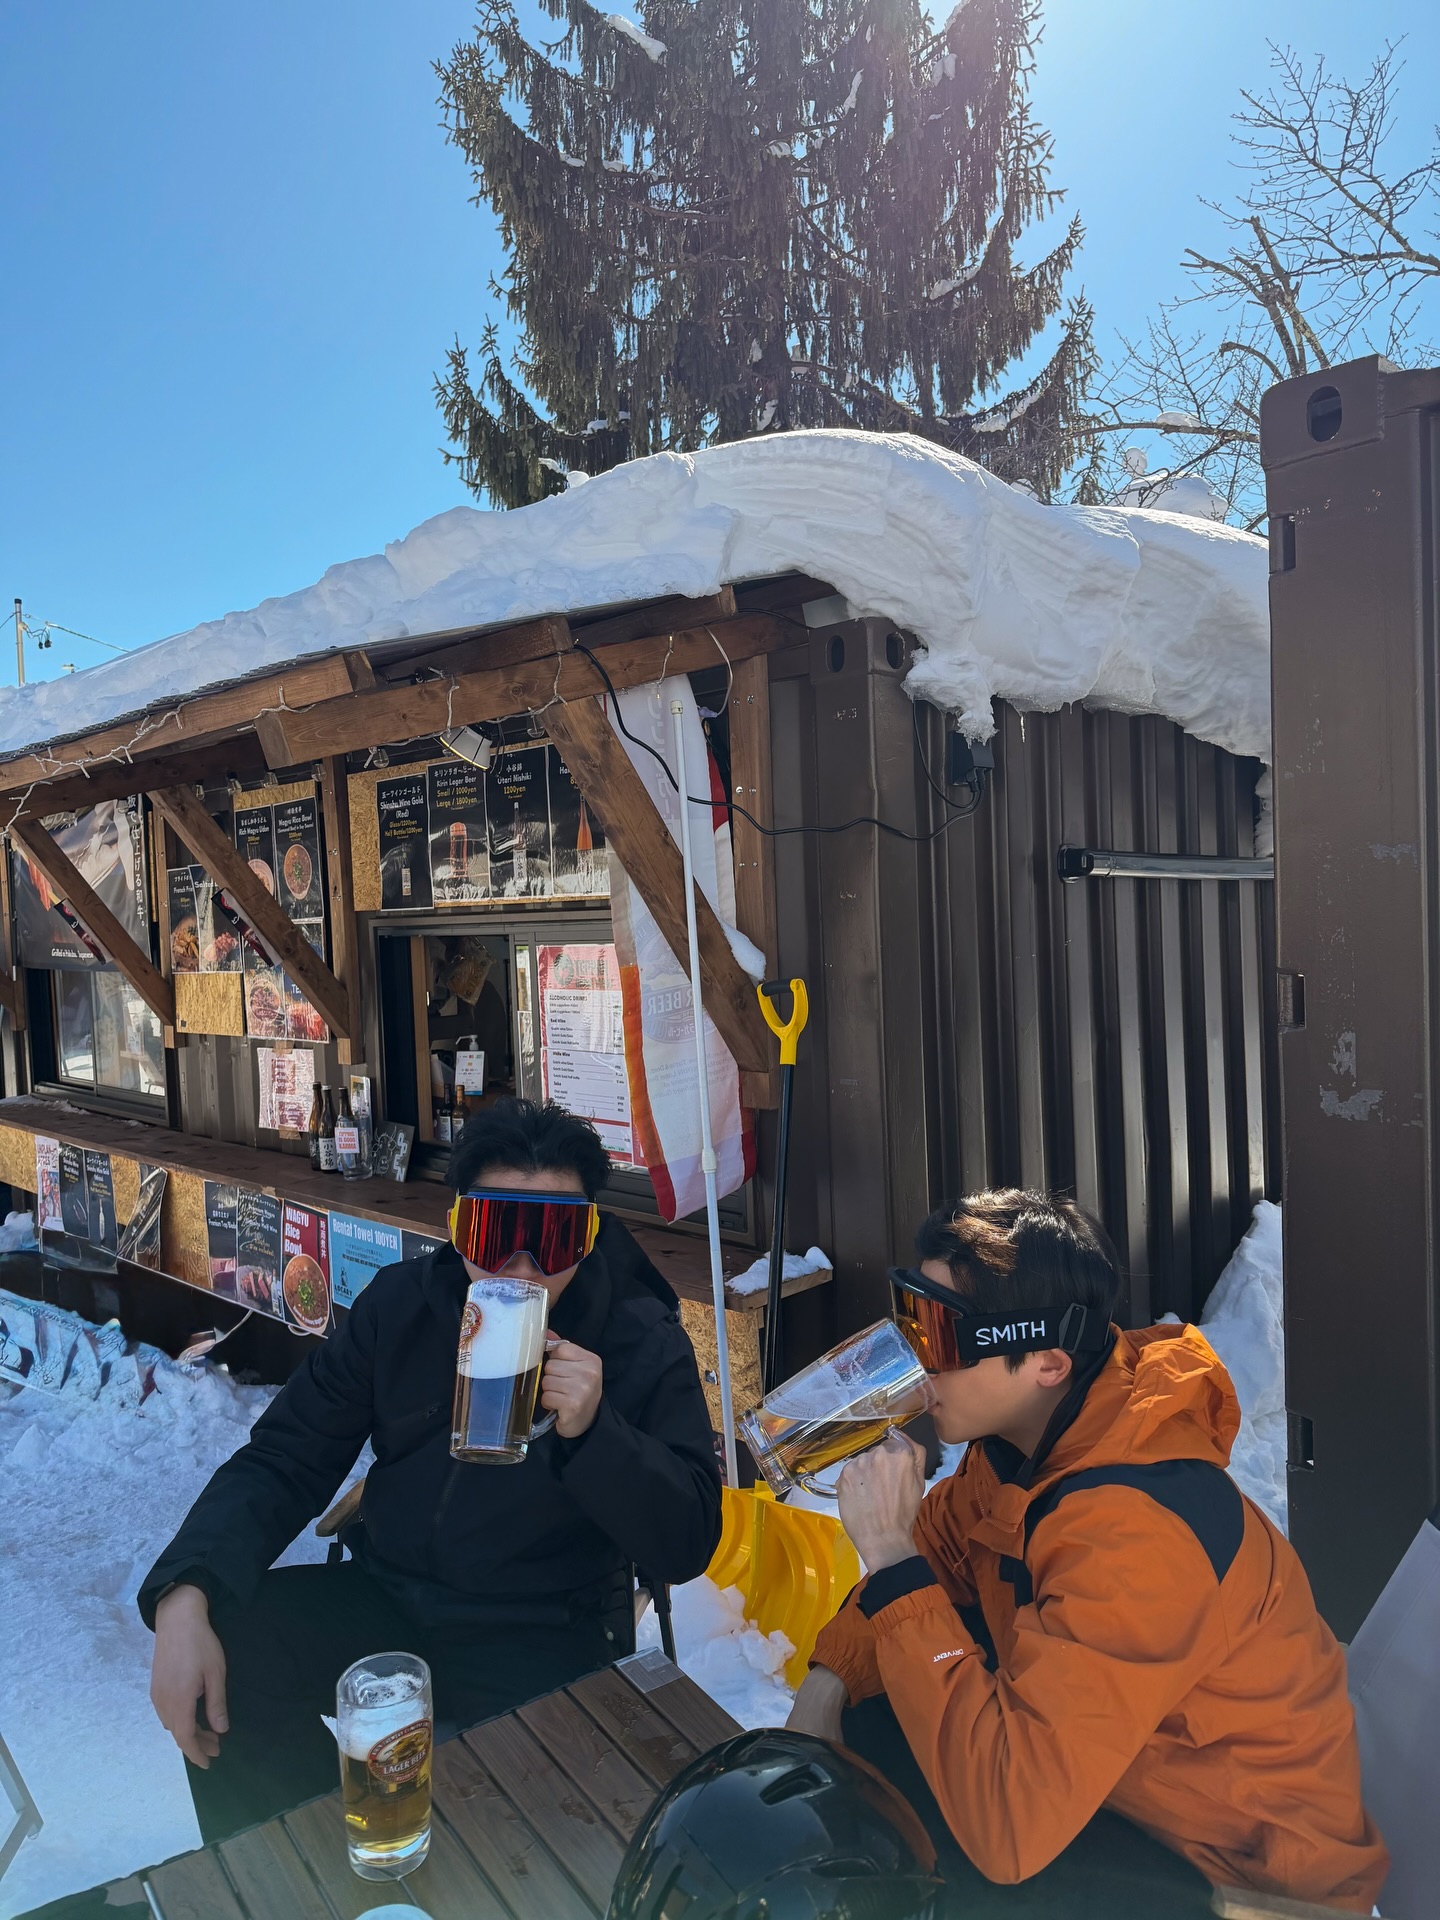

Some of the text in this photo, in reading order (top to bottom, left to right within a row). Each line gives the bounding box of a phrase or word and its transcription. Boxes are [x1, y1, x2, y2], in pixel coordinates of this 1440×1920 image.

[411, 795, 424, 805] Gold
[285, 1206, 309, 1228] WAGYU
[284, 1222, 300, 1240] Rice
[332, 1218, 398, 1250] Rental Towel 100YEN
[284, 1238, 303, 1256] Bowl
[975, 1320, 1046, 1346] SMITH
[933, 1648, 964, 1663] DRYVENT
[384, 1760, 410, 1775] LAGER
[411, 1748, 426, 1765] BEER
